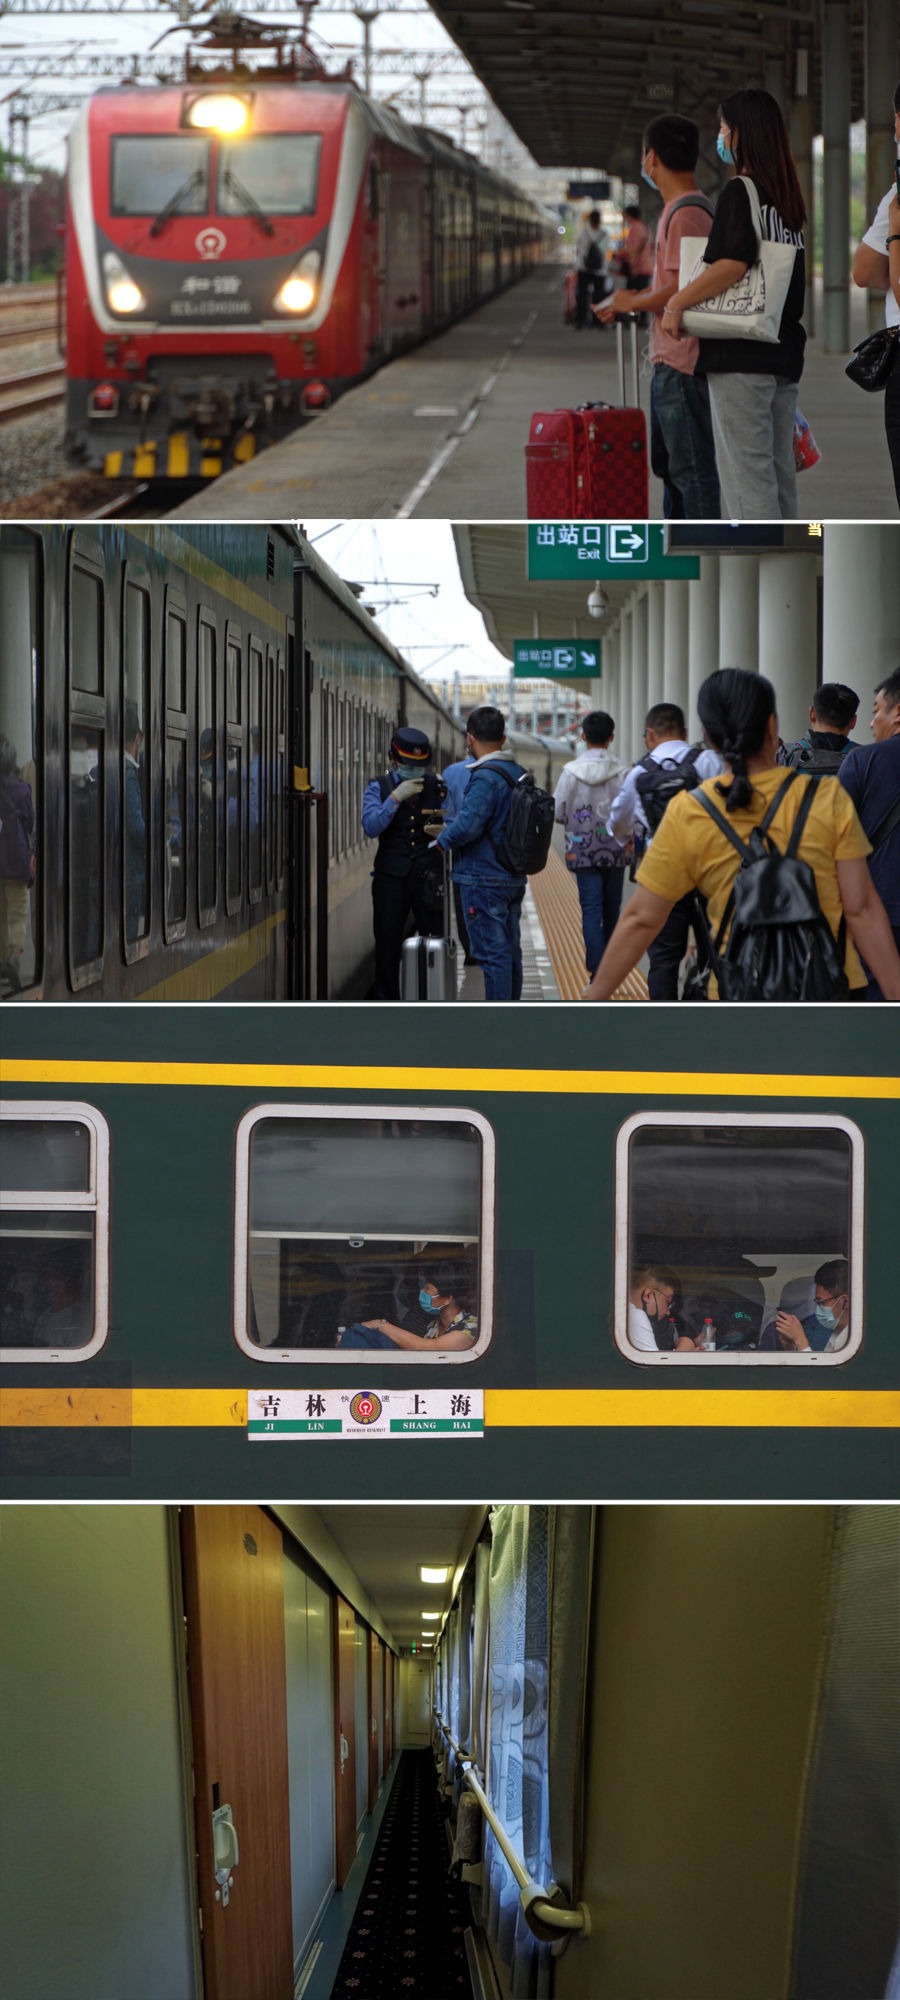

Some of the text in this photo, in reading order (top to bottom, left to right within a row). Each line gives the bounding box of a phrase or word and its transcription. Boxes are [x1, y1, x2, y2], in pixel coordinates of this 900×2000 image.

[181, 275, 242, 295] 和谐
[537, 524, 601, 546] 出站口
[577, 548, 601, 560] Exit
[264, 1422, 325, 1431] JI LIN
[402, 1421, 471, 1430] SHANG HAI
